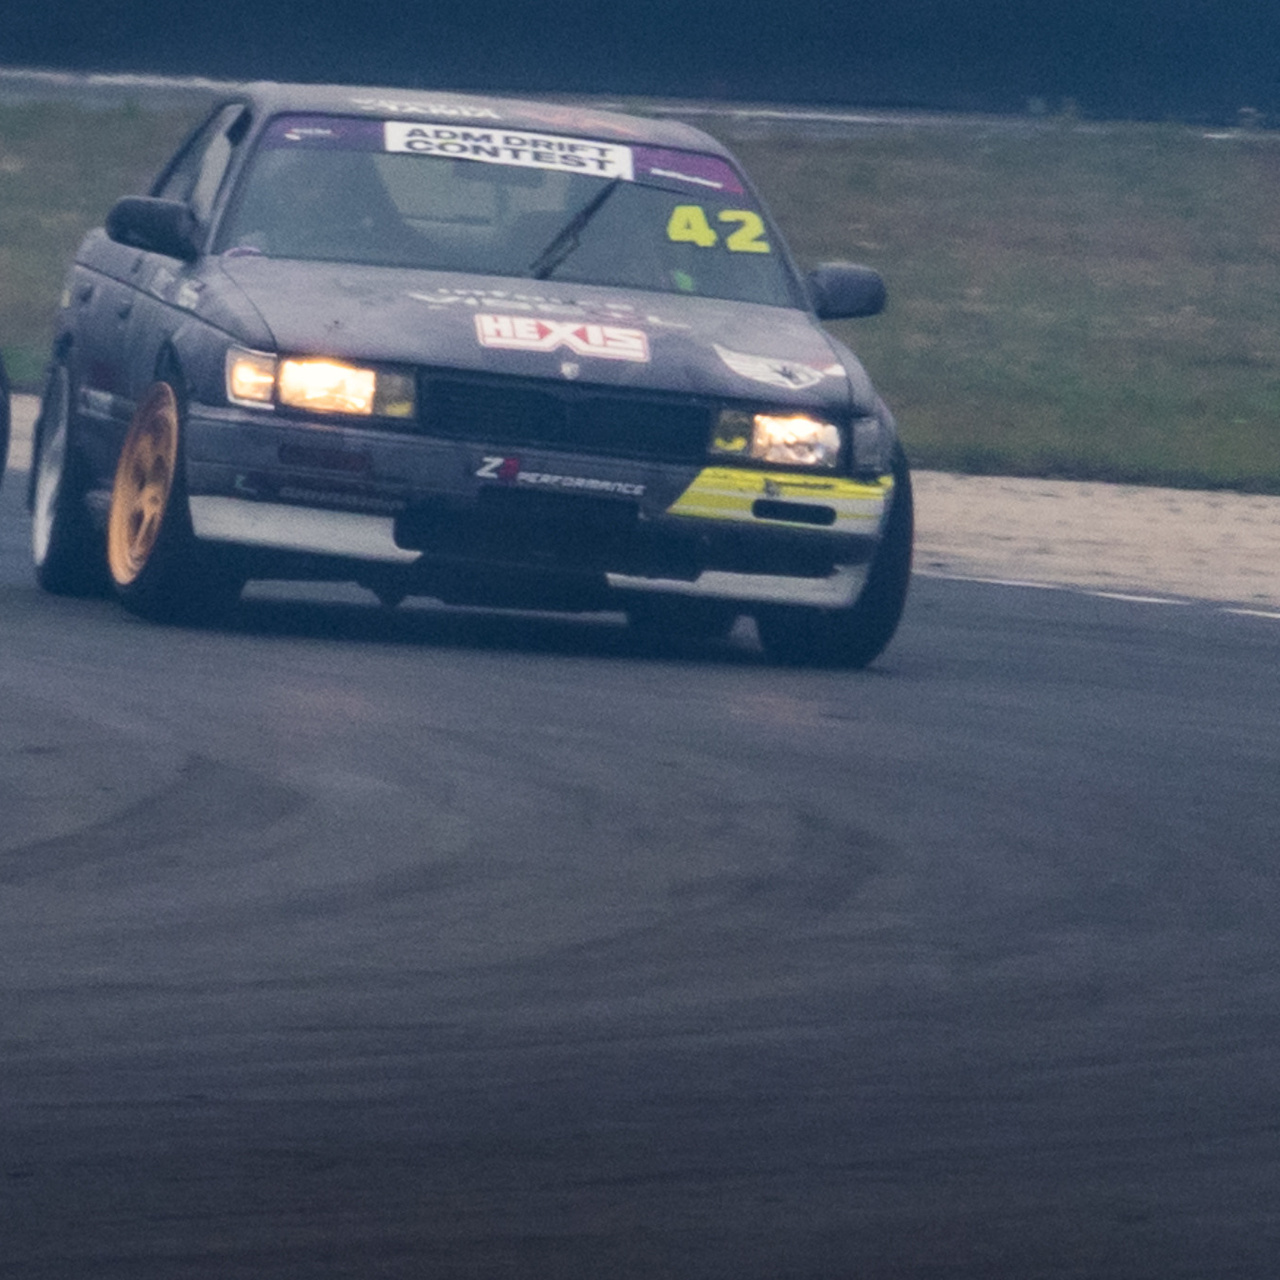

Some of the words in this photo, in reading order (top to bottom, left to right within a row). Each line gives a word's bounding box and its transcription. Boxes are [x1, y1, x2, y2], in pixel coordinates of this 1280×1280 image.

[405, 126, 492, 144] ADM
[502, 133, 612, 158] DRIFT
[405, 138, 614, 172] CONTEST
[666, 204, 771, 254] 42
[480, 314, 648, 353] HEXIS
[516, 471, 646, 496] PERFORMANCE
